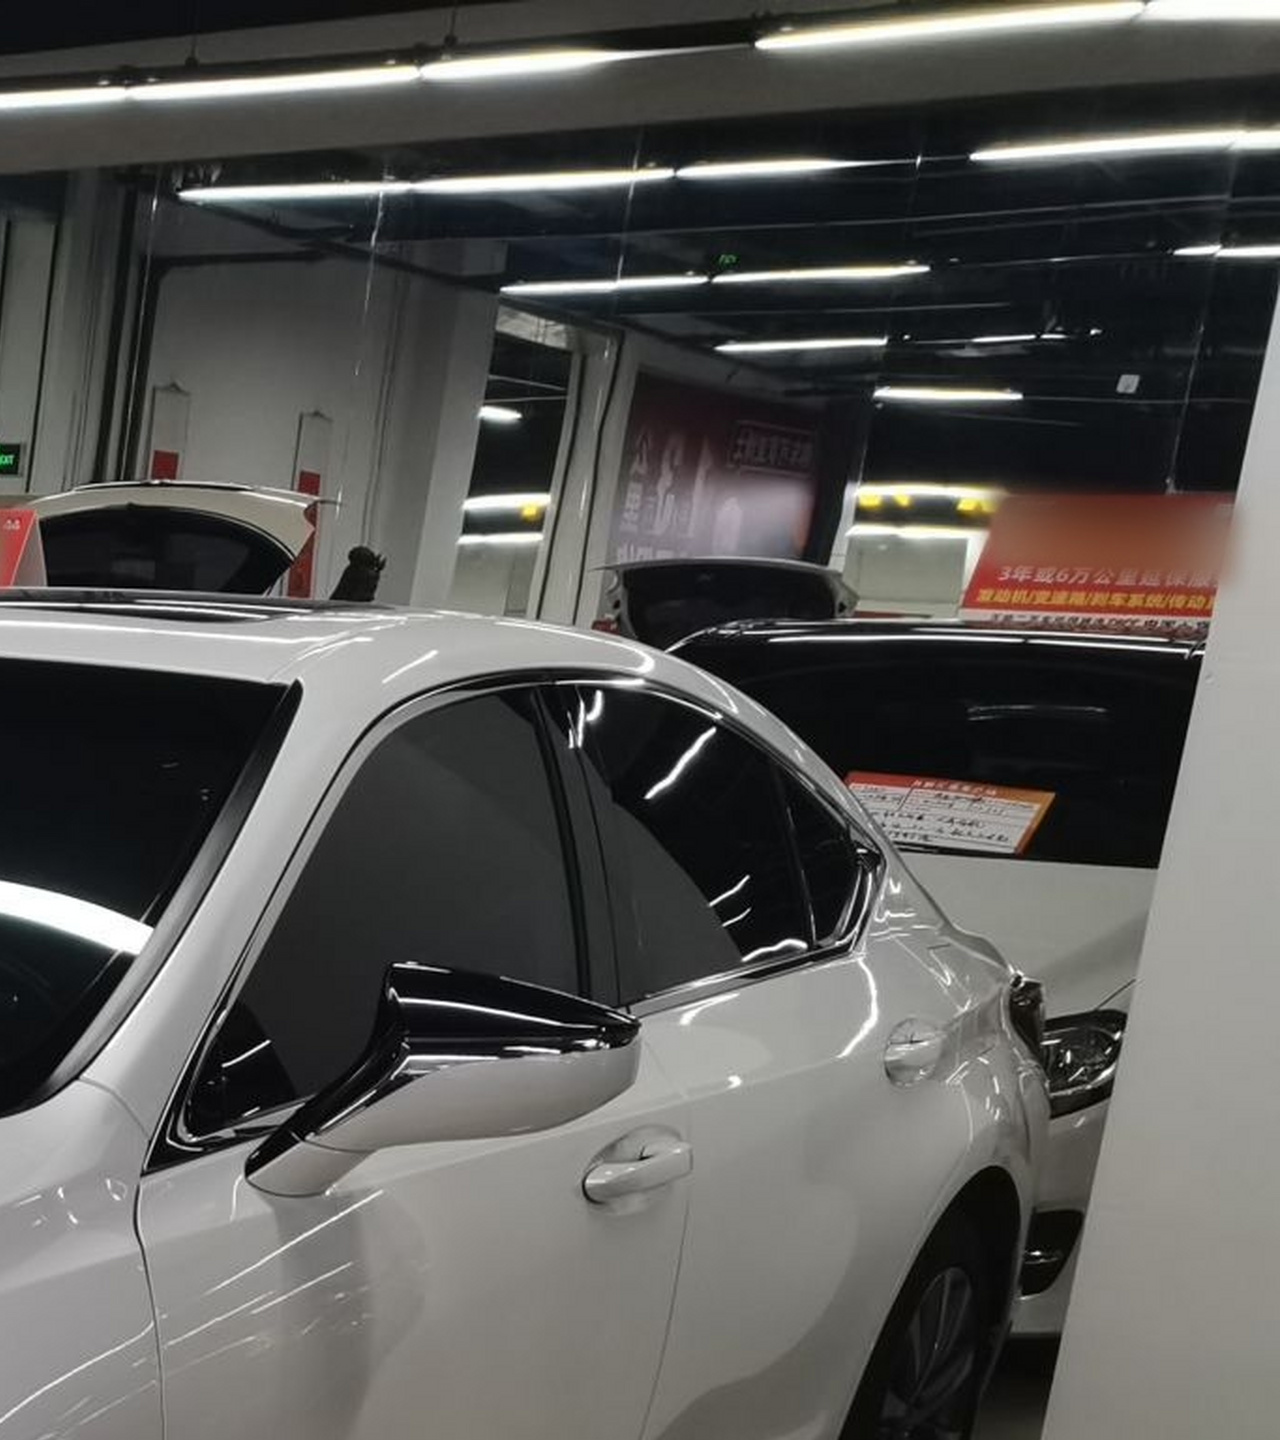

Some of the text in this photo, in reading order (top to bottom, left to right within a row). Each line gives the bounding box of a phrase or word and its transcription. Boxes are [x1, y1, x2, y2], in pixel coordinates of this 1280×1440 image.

[998, 565, 1219, 589] 3年或6万公里延保服
[977, 588, 1215, 610] 发动机/变速箱/刹车系统/传动
